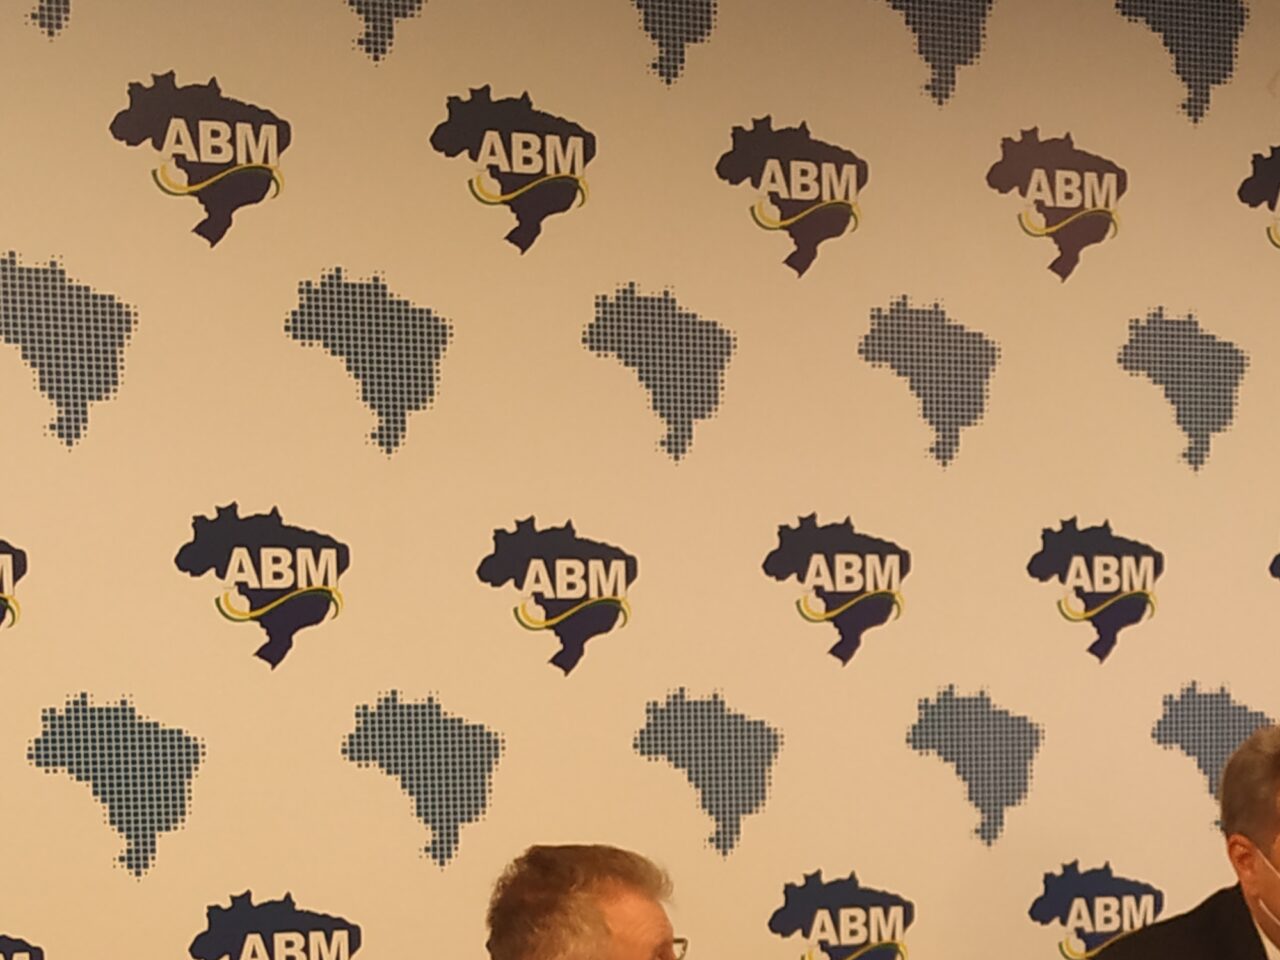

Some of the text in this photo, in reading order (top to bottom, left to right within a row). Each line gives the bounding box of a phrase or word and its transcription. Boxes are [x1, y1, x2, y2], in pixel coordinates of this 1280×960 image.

[160, 118, 279, 165] ABM
[477, 131, 584, 177] ABM
[759, 159, 858, 202] ABM
[1026, 169, 1118, 209] ABM
[224, 548, 339, 589] ABM
[522, 560, 627, 600] ABM
[803, 554, 900, 592] ABM
[1064, 556, 1154, 592] ABM
[807, 906, 904, 945] ABM
[1064, 895, 1155, 933] ABM
